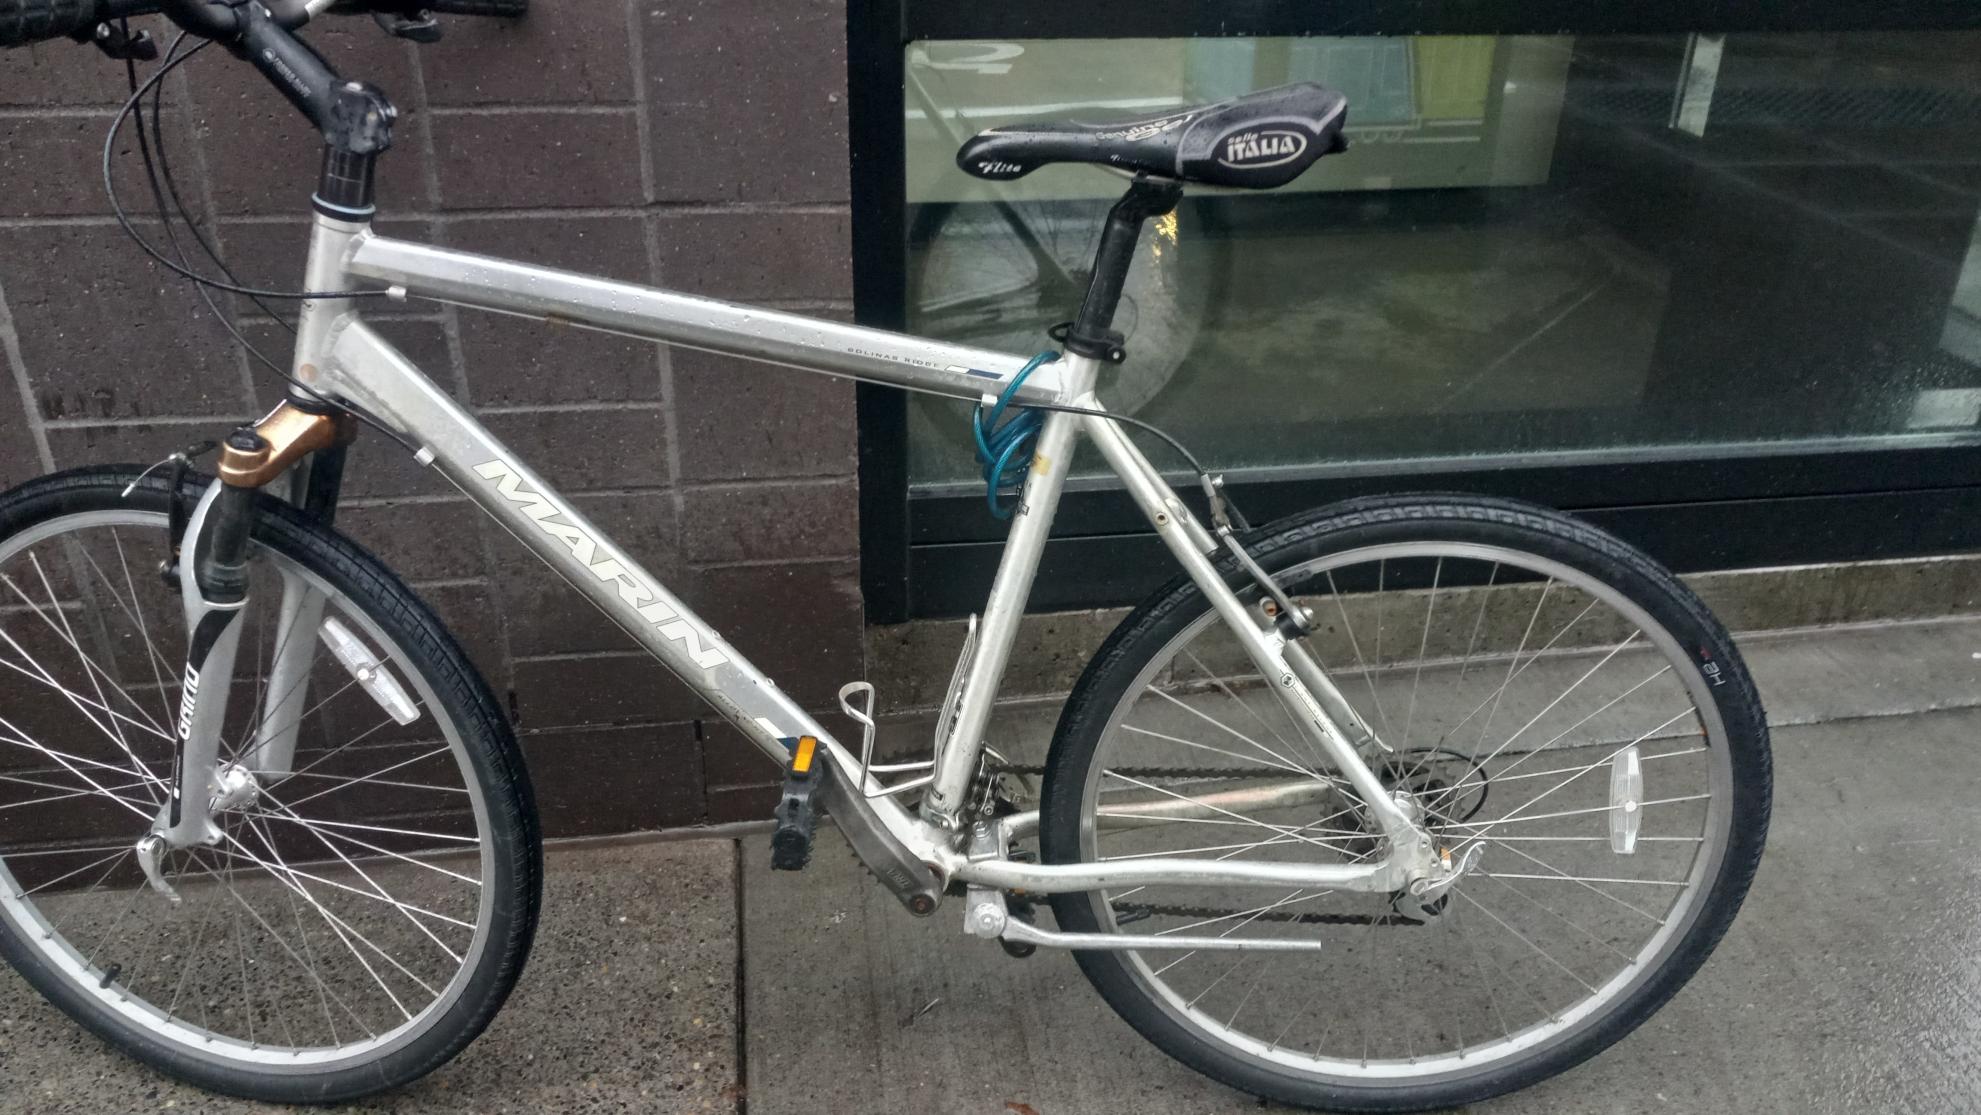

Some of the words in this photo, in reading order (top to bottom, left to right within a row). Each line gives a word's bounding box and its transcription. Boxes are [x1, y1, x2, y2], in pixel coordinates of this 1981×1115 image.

[1227, 136, 1296, 163] ITALIA
[847, 348, 899, 361] BOLINAS
[472, 459, 730, 669] MARIN
